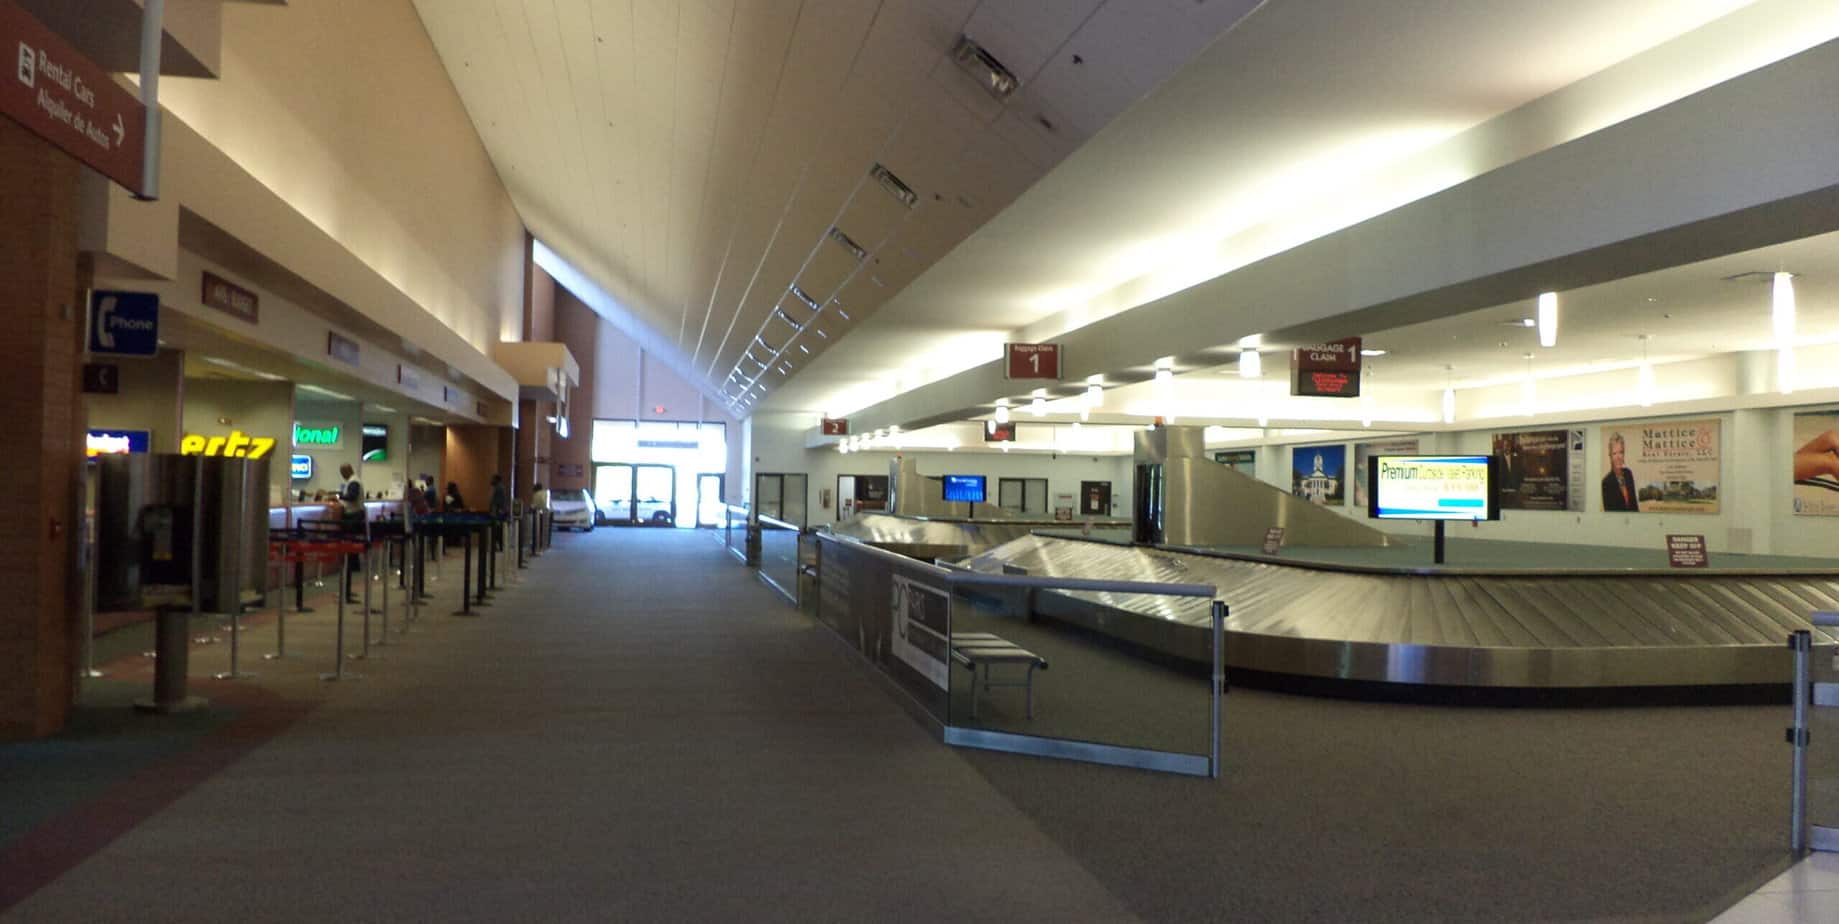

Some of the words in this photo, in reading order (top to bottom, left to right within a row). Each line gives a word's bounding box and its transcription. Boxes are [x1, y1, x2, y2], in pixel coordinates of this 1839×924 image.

[38, 48, 73, 92] Rental
[73, 76, 95, 109] Cars
[37, 87, 73, 125] Alquiler
[73, 112, 86, 134] de
[86, 121, 110, 151] Autos
[110, 315, 154, 331] Phone
[1029, 353, 1039, 373] 1
[1347, 345, 1356, 362] 1
[1643, 428, 1696, 439] Mattice
[180, 430, 275, 460] ertz
[1642, 439, 1696, 449] Mattice
[1382, 462, 1418, 481] Premium
